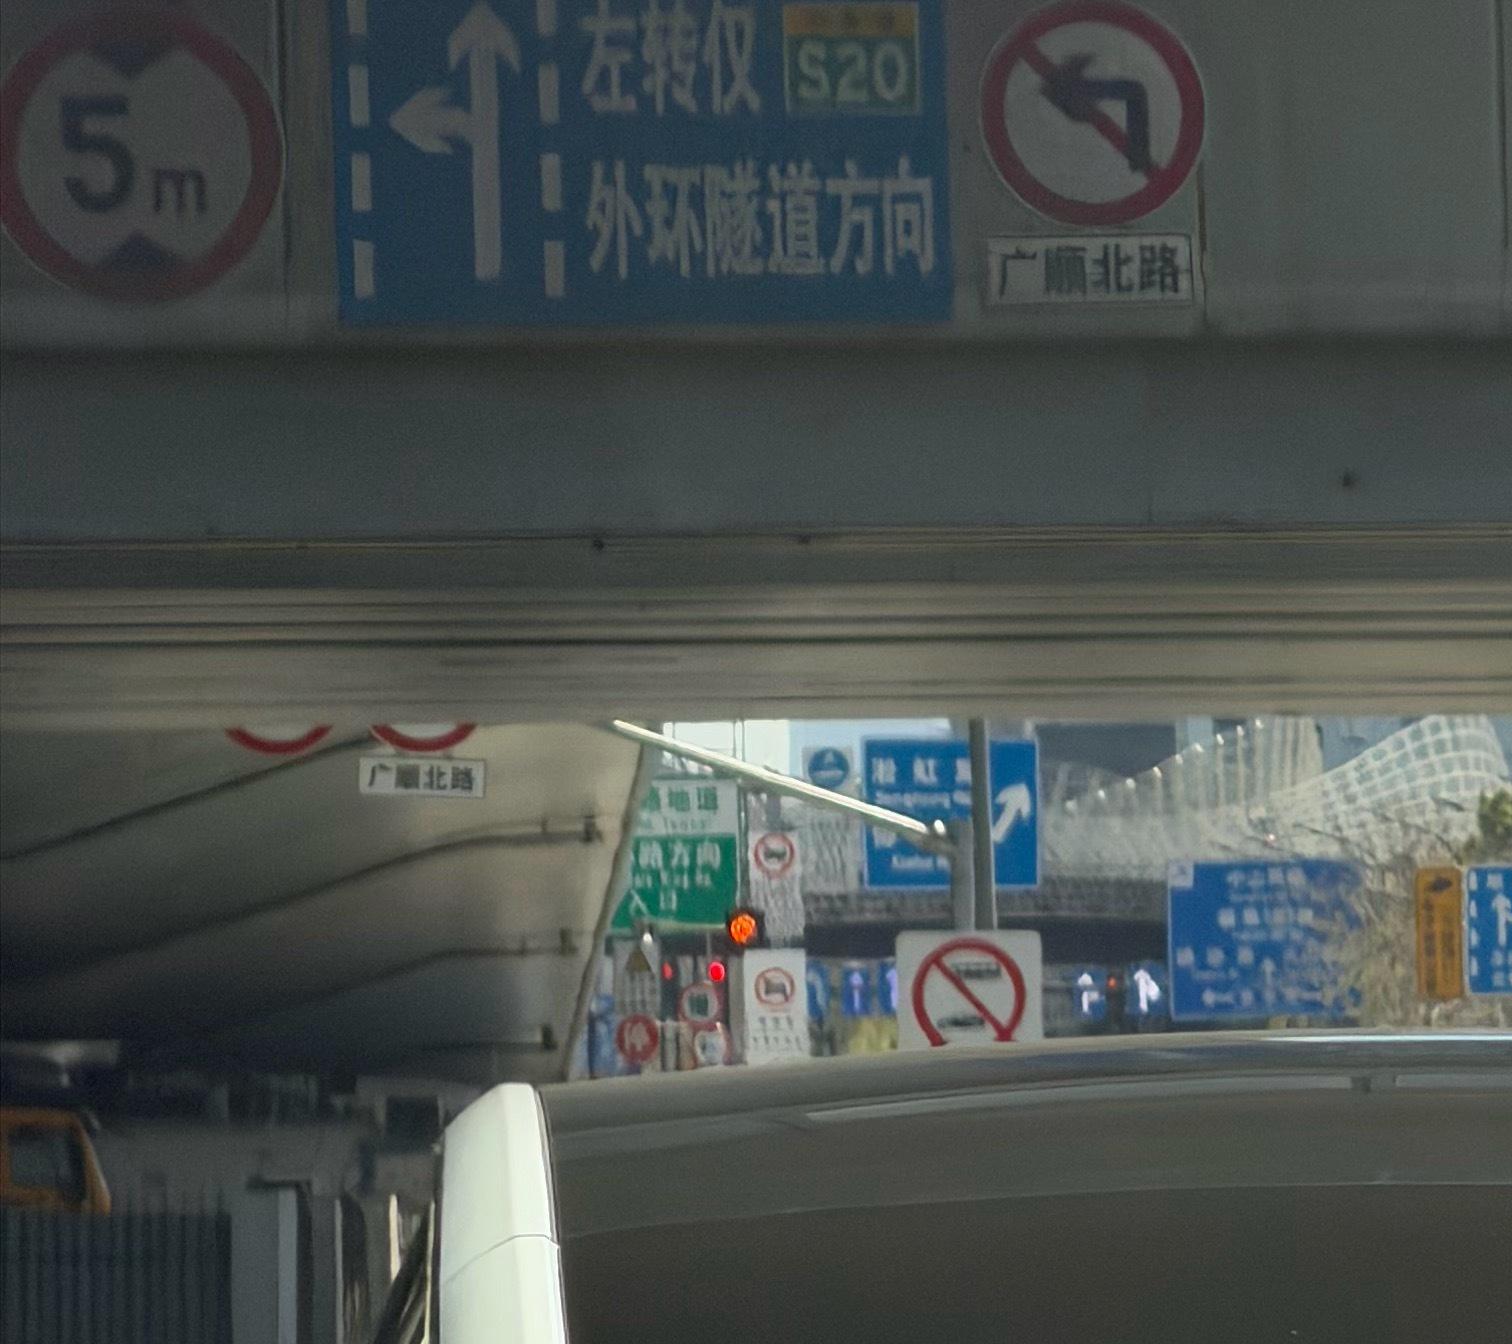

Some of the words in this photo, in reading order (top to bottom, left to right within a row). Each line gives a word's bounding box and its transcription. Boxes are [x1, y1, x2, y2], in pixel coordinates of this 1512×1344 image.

[580, 0, 761, 115] 左转仅
[798, 39, 907, 102] S20
[585, 157, 935, 280] 外环隧道方向
[1001, 242, 1182, 296] 广顺北路
